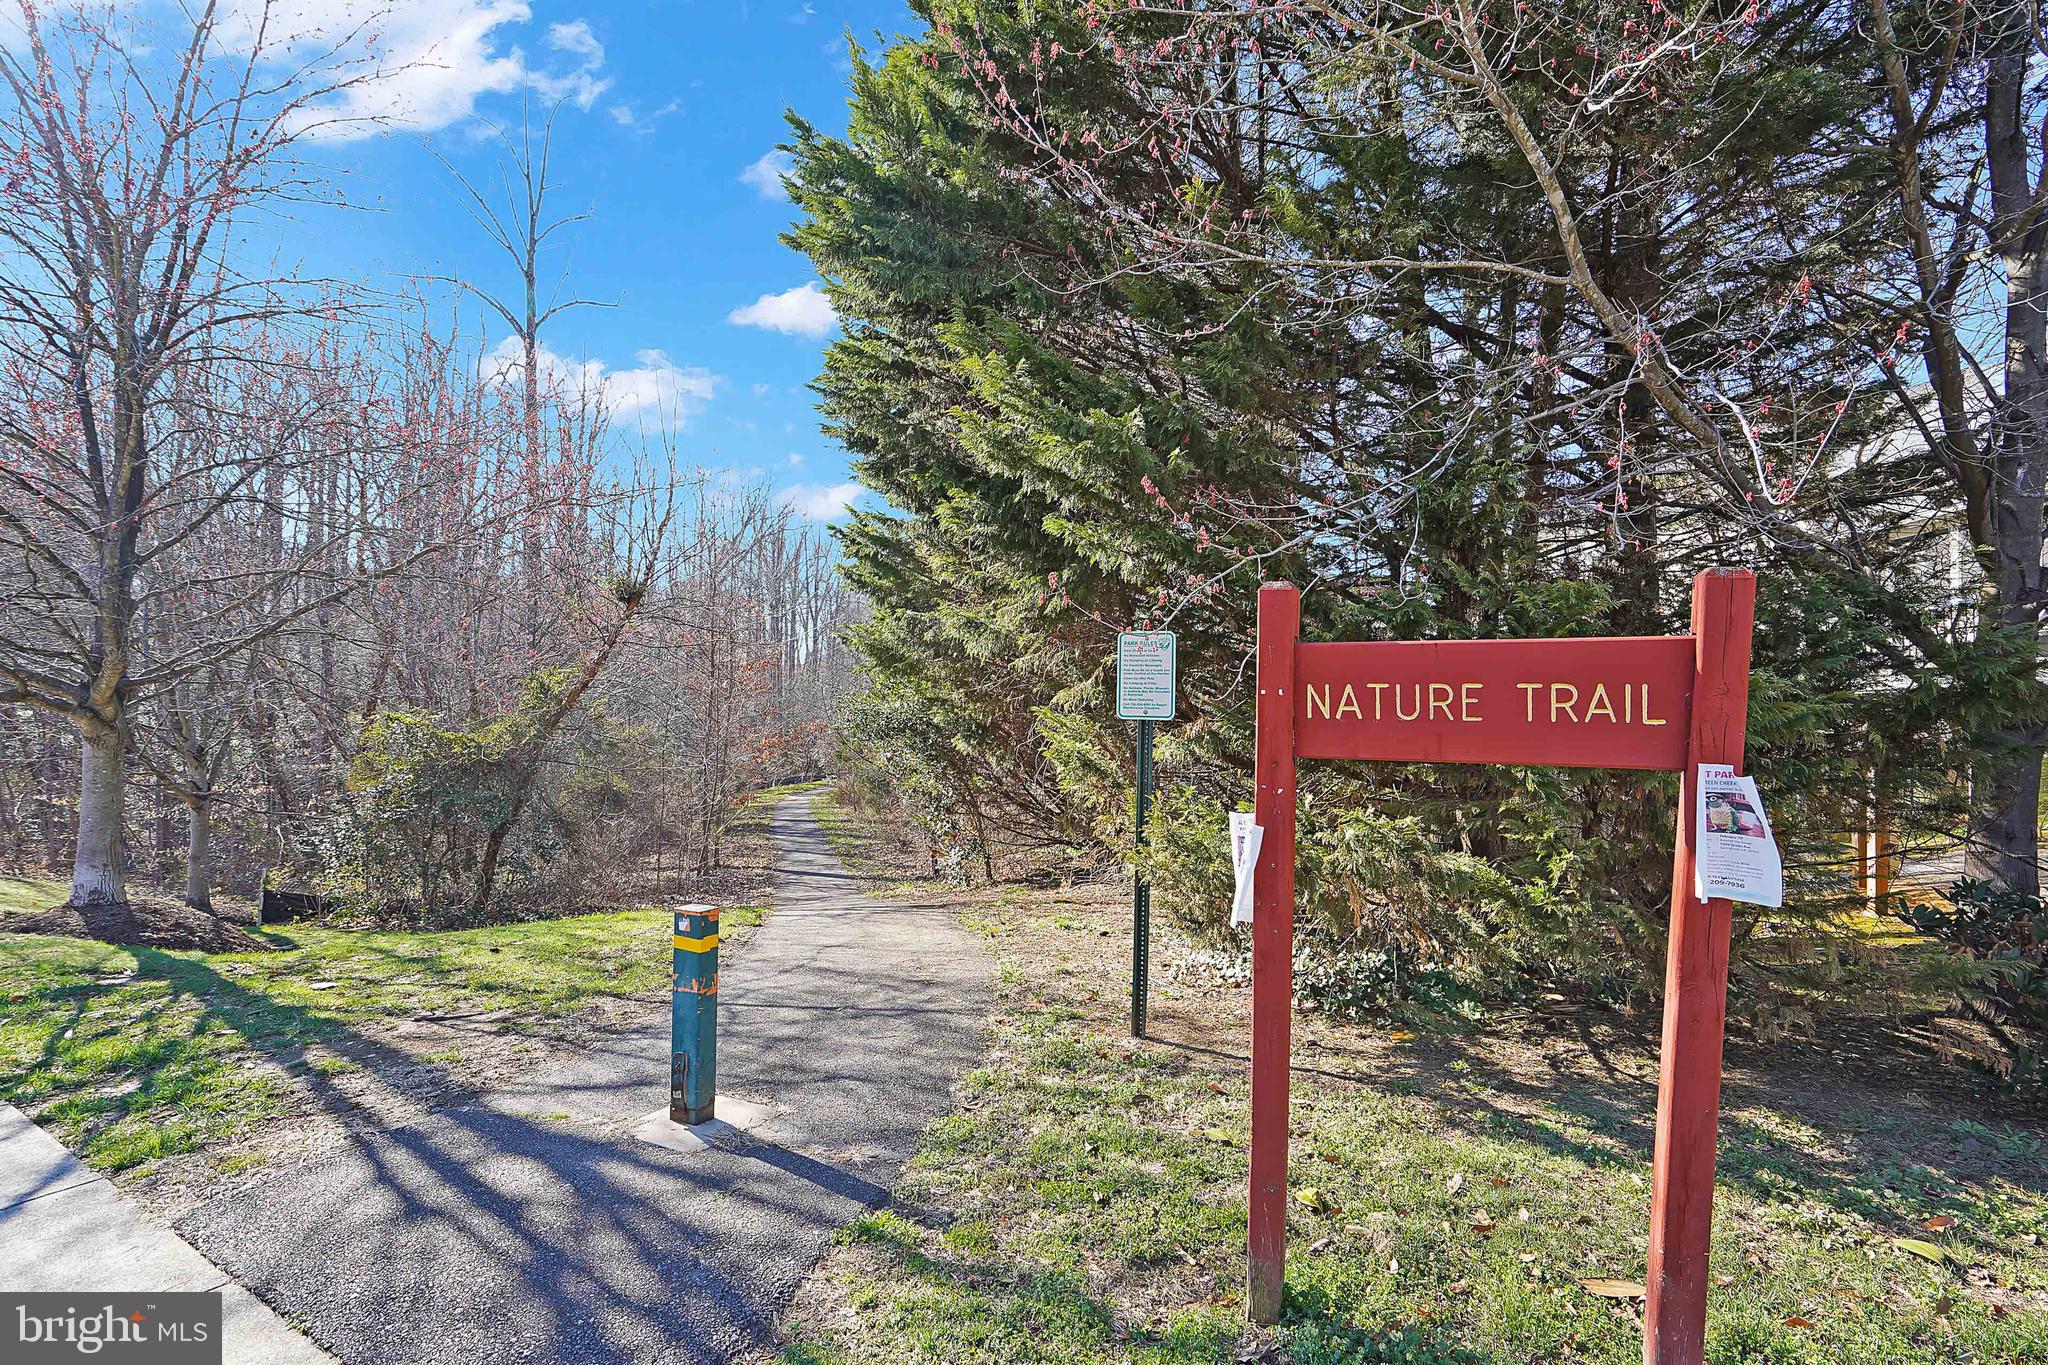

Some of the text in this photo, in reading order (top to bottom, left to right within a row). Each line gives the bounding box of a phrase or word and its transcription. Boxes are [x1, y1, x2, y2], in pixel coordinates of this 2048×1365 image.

[1306, 682, 1667, 726] NATURE TRAIL
[1705, 770, 1712, 778] T
